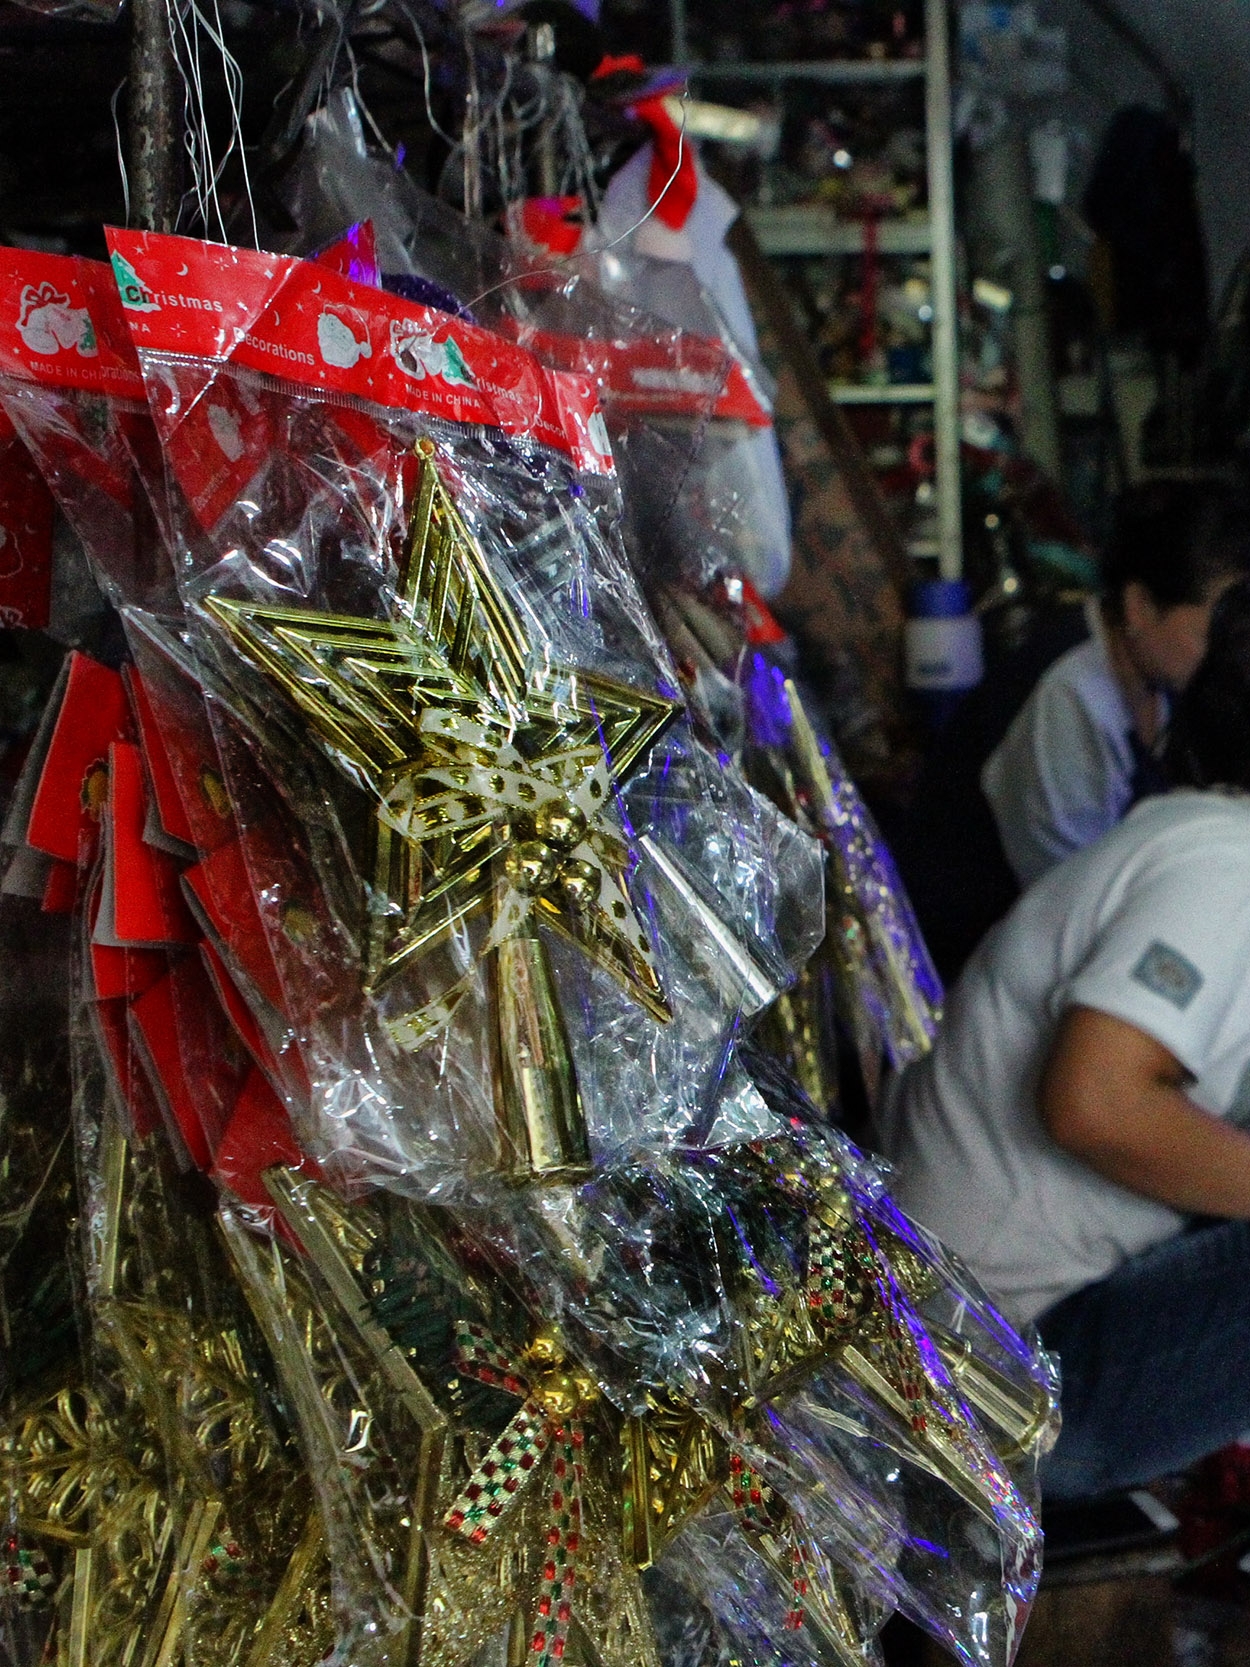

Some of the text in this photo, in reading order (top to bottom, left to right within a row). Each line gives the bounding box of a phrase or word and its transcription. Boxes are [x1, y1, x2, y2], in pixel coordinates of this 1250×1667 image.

[125, 285, 224, 313] Christmas
[233, 326, 315, 366] Decorations
[65, 367, 78, 377] IN
[431, 392, 443, 403] IN
[445, 393, 481, 409] CHINA
